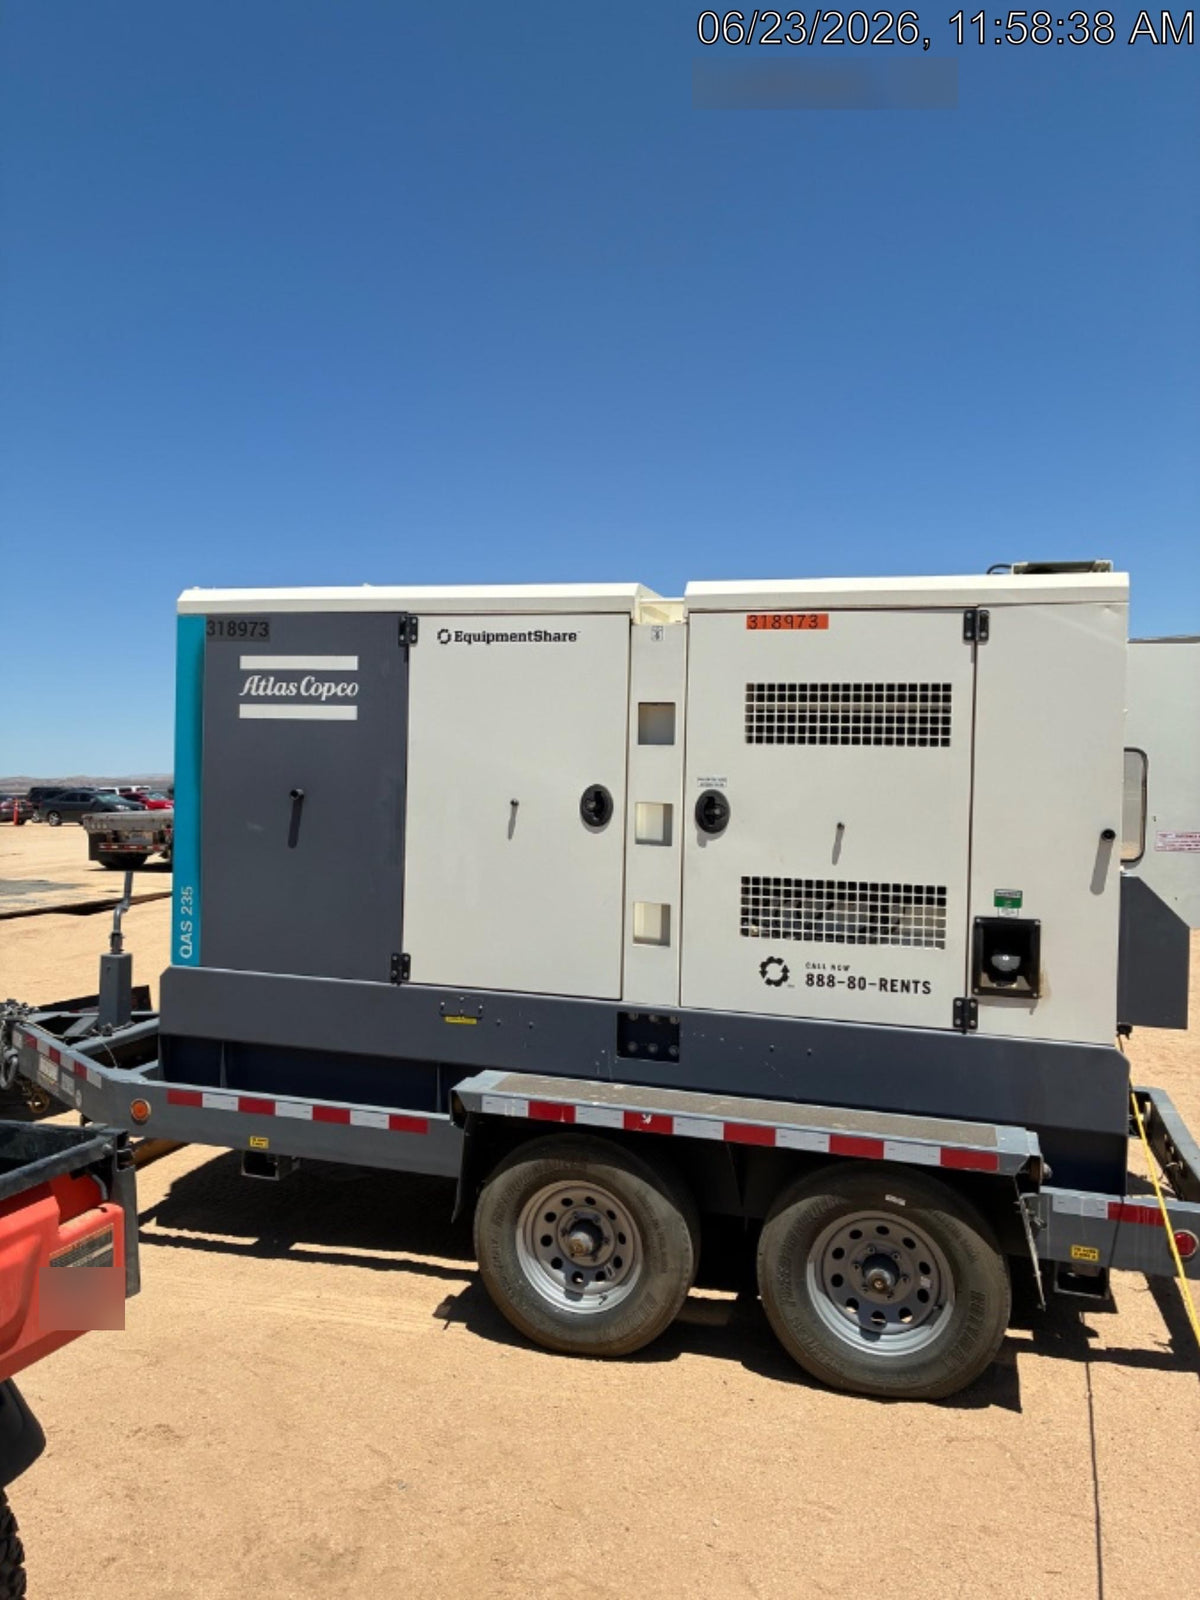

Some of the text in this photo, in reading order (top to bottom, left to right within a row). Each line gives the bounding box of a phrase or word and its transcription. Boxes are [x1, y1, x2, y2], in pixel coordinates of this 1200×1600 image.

[206, 620, 269, 637] 318973
[747, 614, 818, 630] 318973
[454, 630, 577, 645] EquipmentShare
[239, 674, 359, 701] Atlas Copco
[179, 886, 193, 959] QAS 235
[805, 961, 826, 970] CALL
[805, 972, 931, 995] 888-80-RENTS
